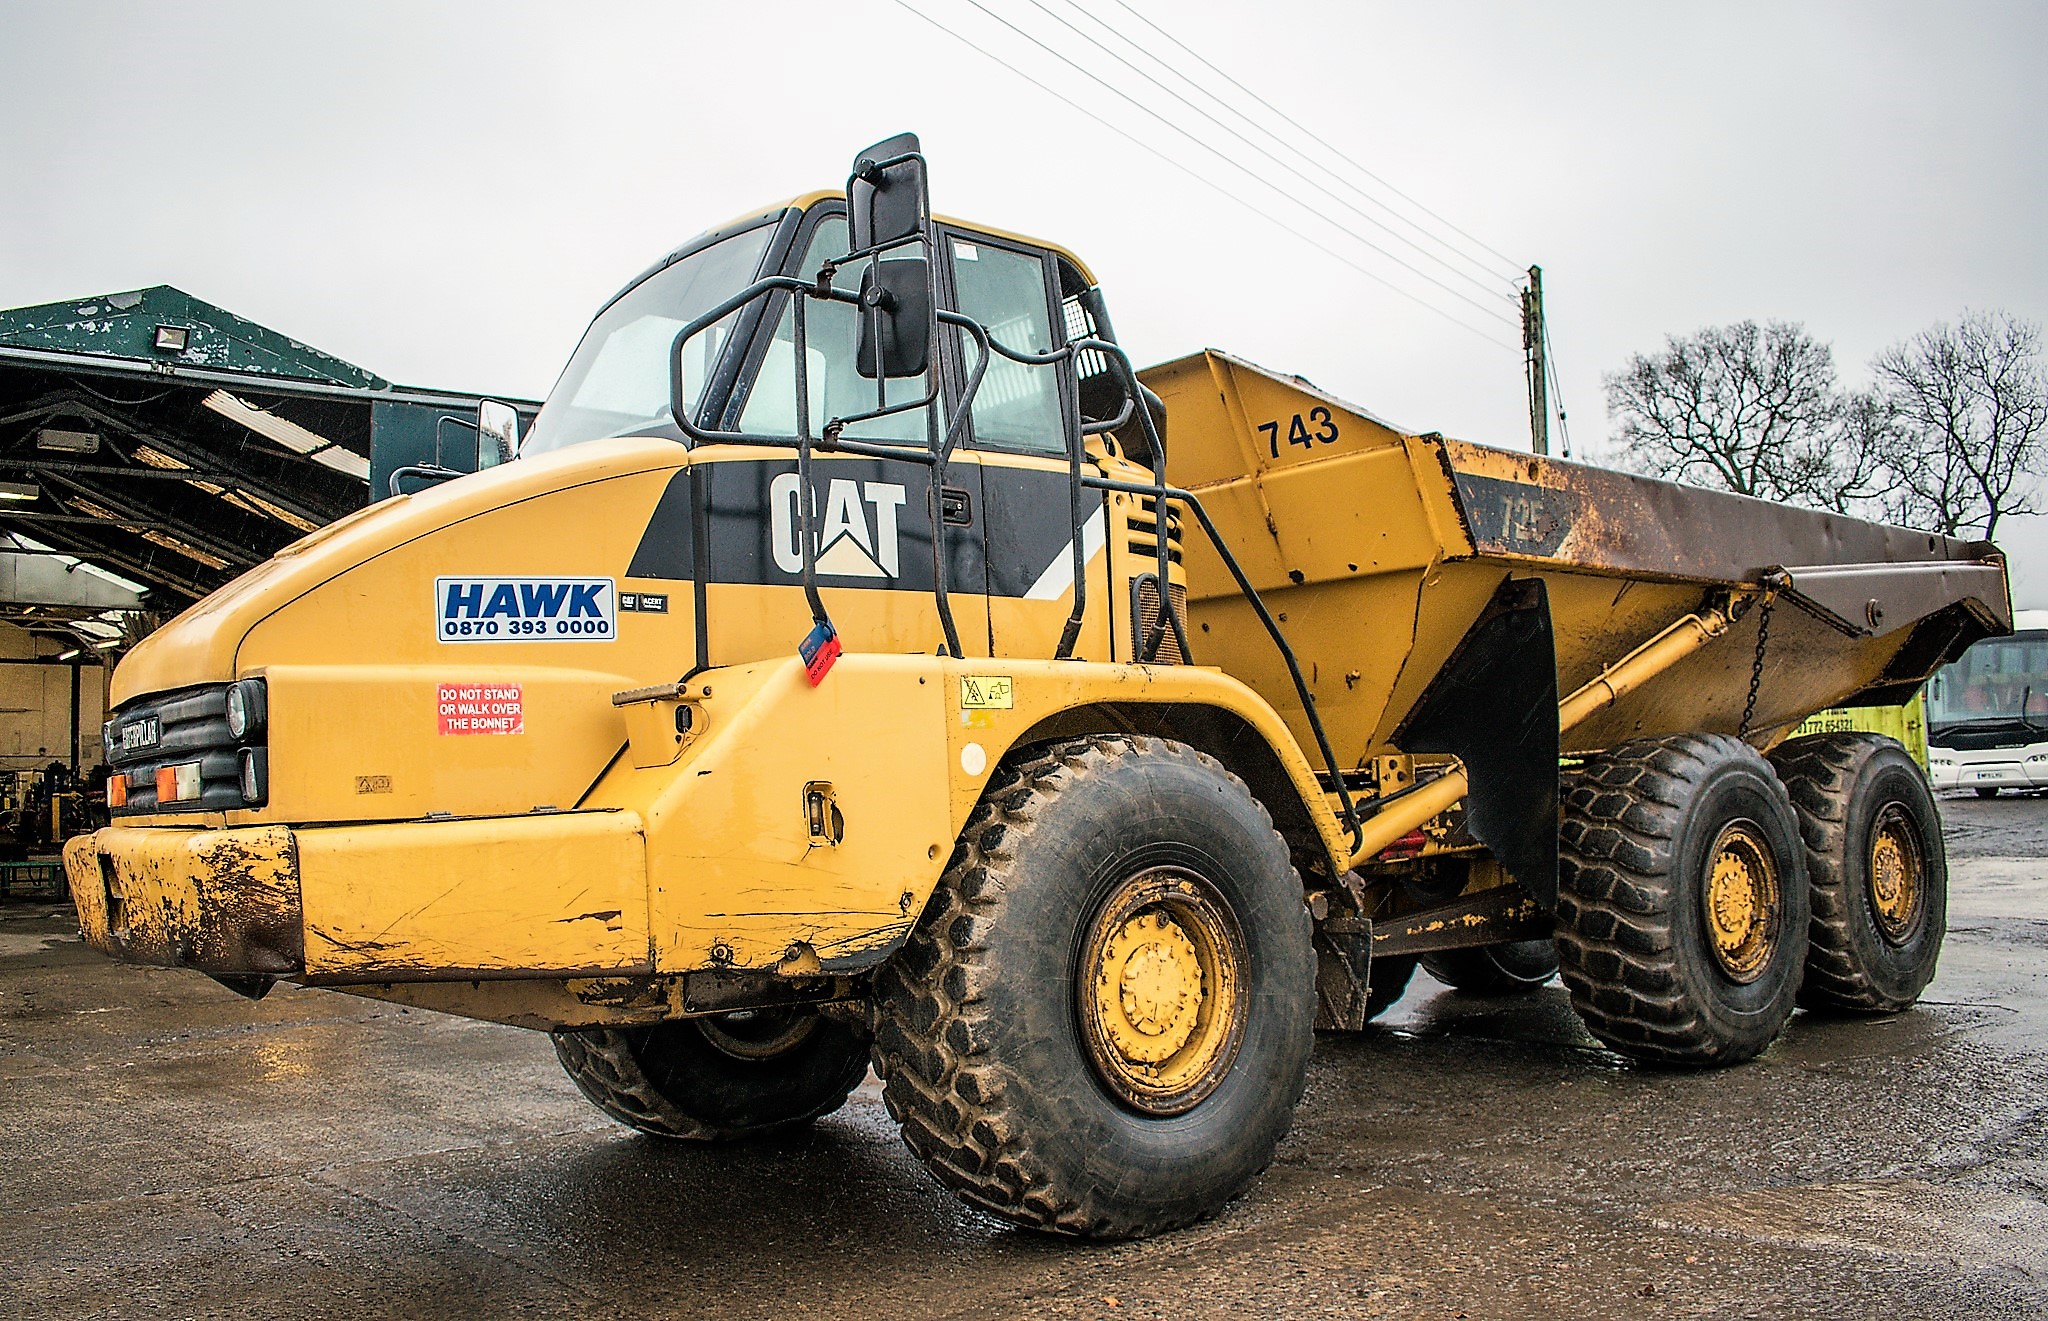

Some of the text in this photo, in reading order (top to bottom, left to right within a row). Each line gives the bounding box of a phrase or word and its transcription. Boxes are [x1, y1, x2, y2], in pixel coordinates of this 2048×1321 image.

[1257, 406, 1339, 459] 743
[770, 472, 907, 579] CAT
[444, 583, 607, 619] HAWK
[444, 620, 609, 635] 0870 393 0000
[440, 688, 519, 701] DO NOT STAND
[439, 703, 521, 715] OR WALK OVER
[447, 718, 515, 730] THE BONNET
